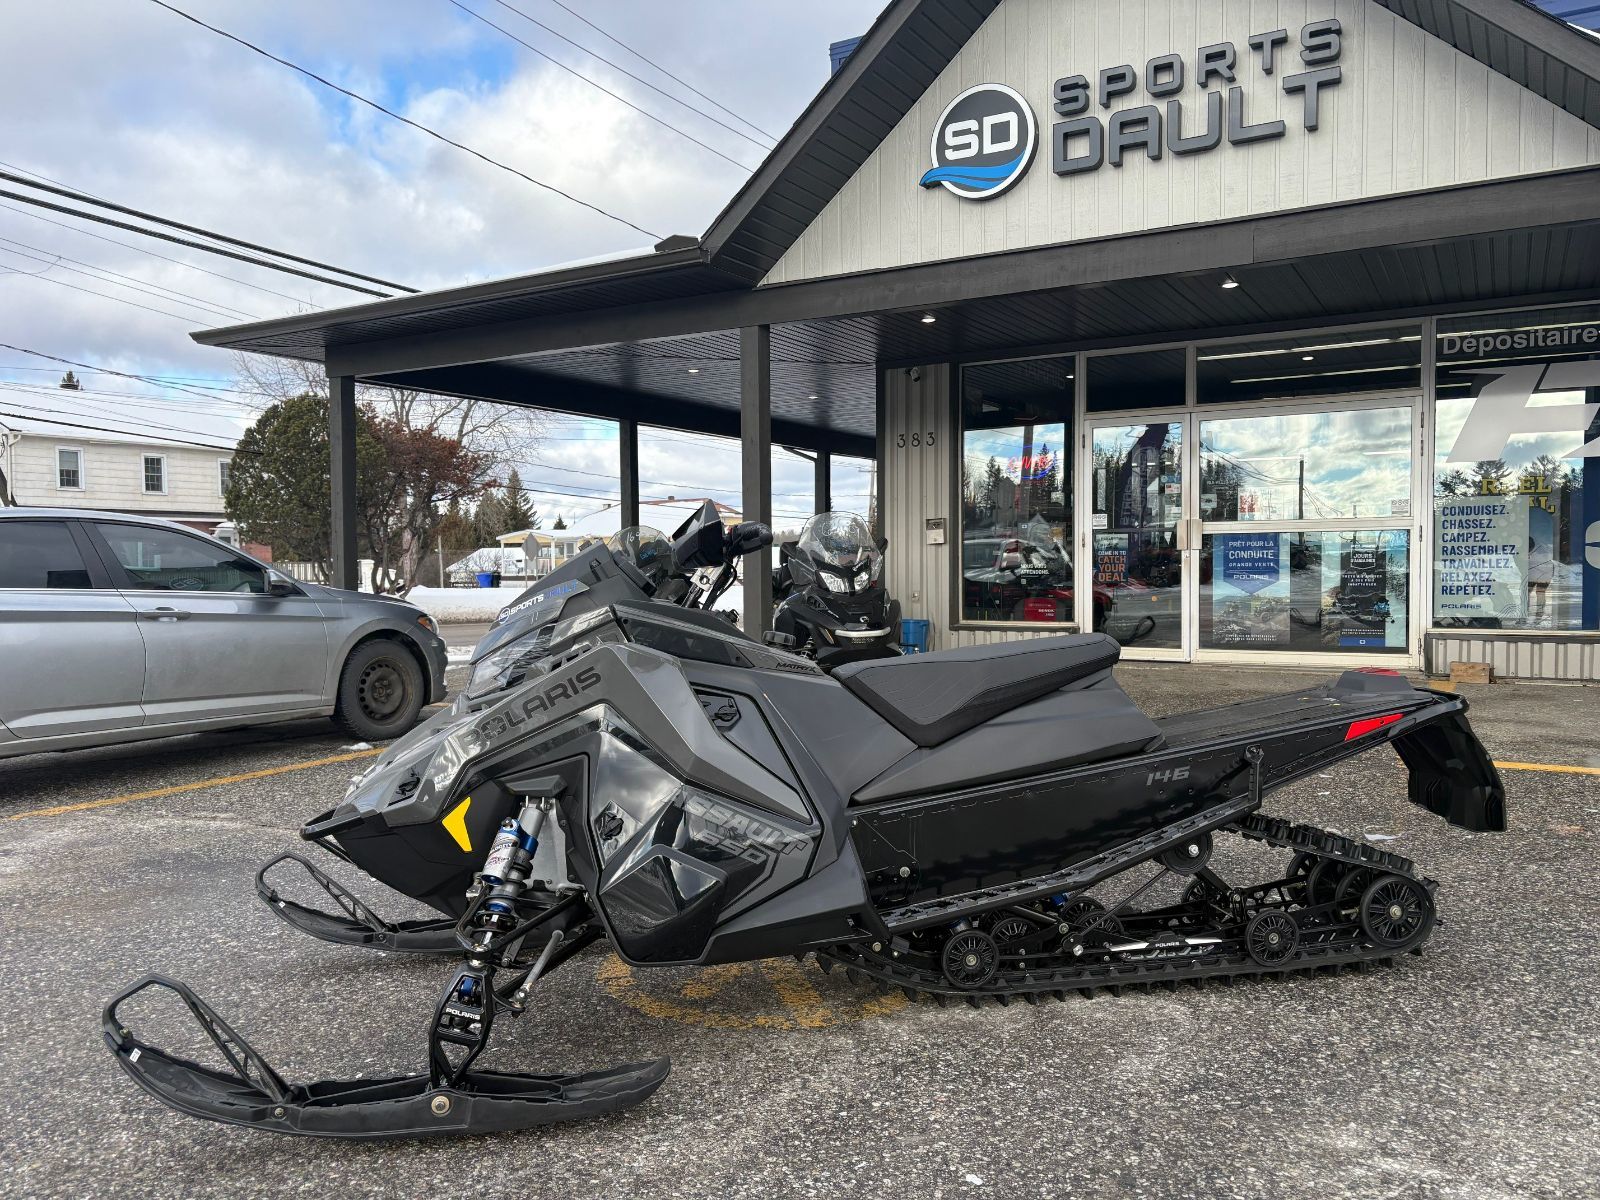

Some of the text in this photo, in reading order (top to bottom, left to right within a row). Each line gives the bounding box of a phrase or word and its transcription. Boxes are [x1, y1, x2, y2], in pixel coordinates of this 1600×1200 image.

[1053, 19, 1342, 117] SPORTS
[1053, 66, 1342, 176] DAULT
[944, 111, 1019, 161] SD
[1442, 325, 1598, 357] Dépositaire
[1442, 504, 1510, 516] CONDUISEZ.
[1441, 518, 1497, 530] CHASSEZ.
[1441, 532, 1491, 542] CAMPEZ.
[1228, 550, 1274, 560] CONDUITE
[1441, 544, 1520, 556] RASSEMBLEZ.
[1098, 556, 1126, 564] CATCH
[1441, 558, 1514, 569] TRAVAILLEZ.
[1098, 564, 1126, 572] YOUR
[1098, 572, 1126, 582] DEAL
[1441, 572, 1497, 582] RELAXEZ.
[1441, 582, 1496, 596] RÉPÉTEZ.
[510, 594, 544, 615] SPORTS
[463, 666, 602, 750] POLARIS
[1146, 765, 1191, 786] 146
[446, 1008, 480, 1020] POLARIS
